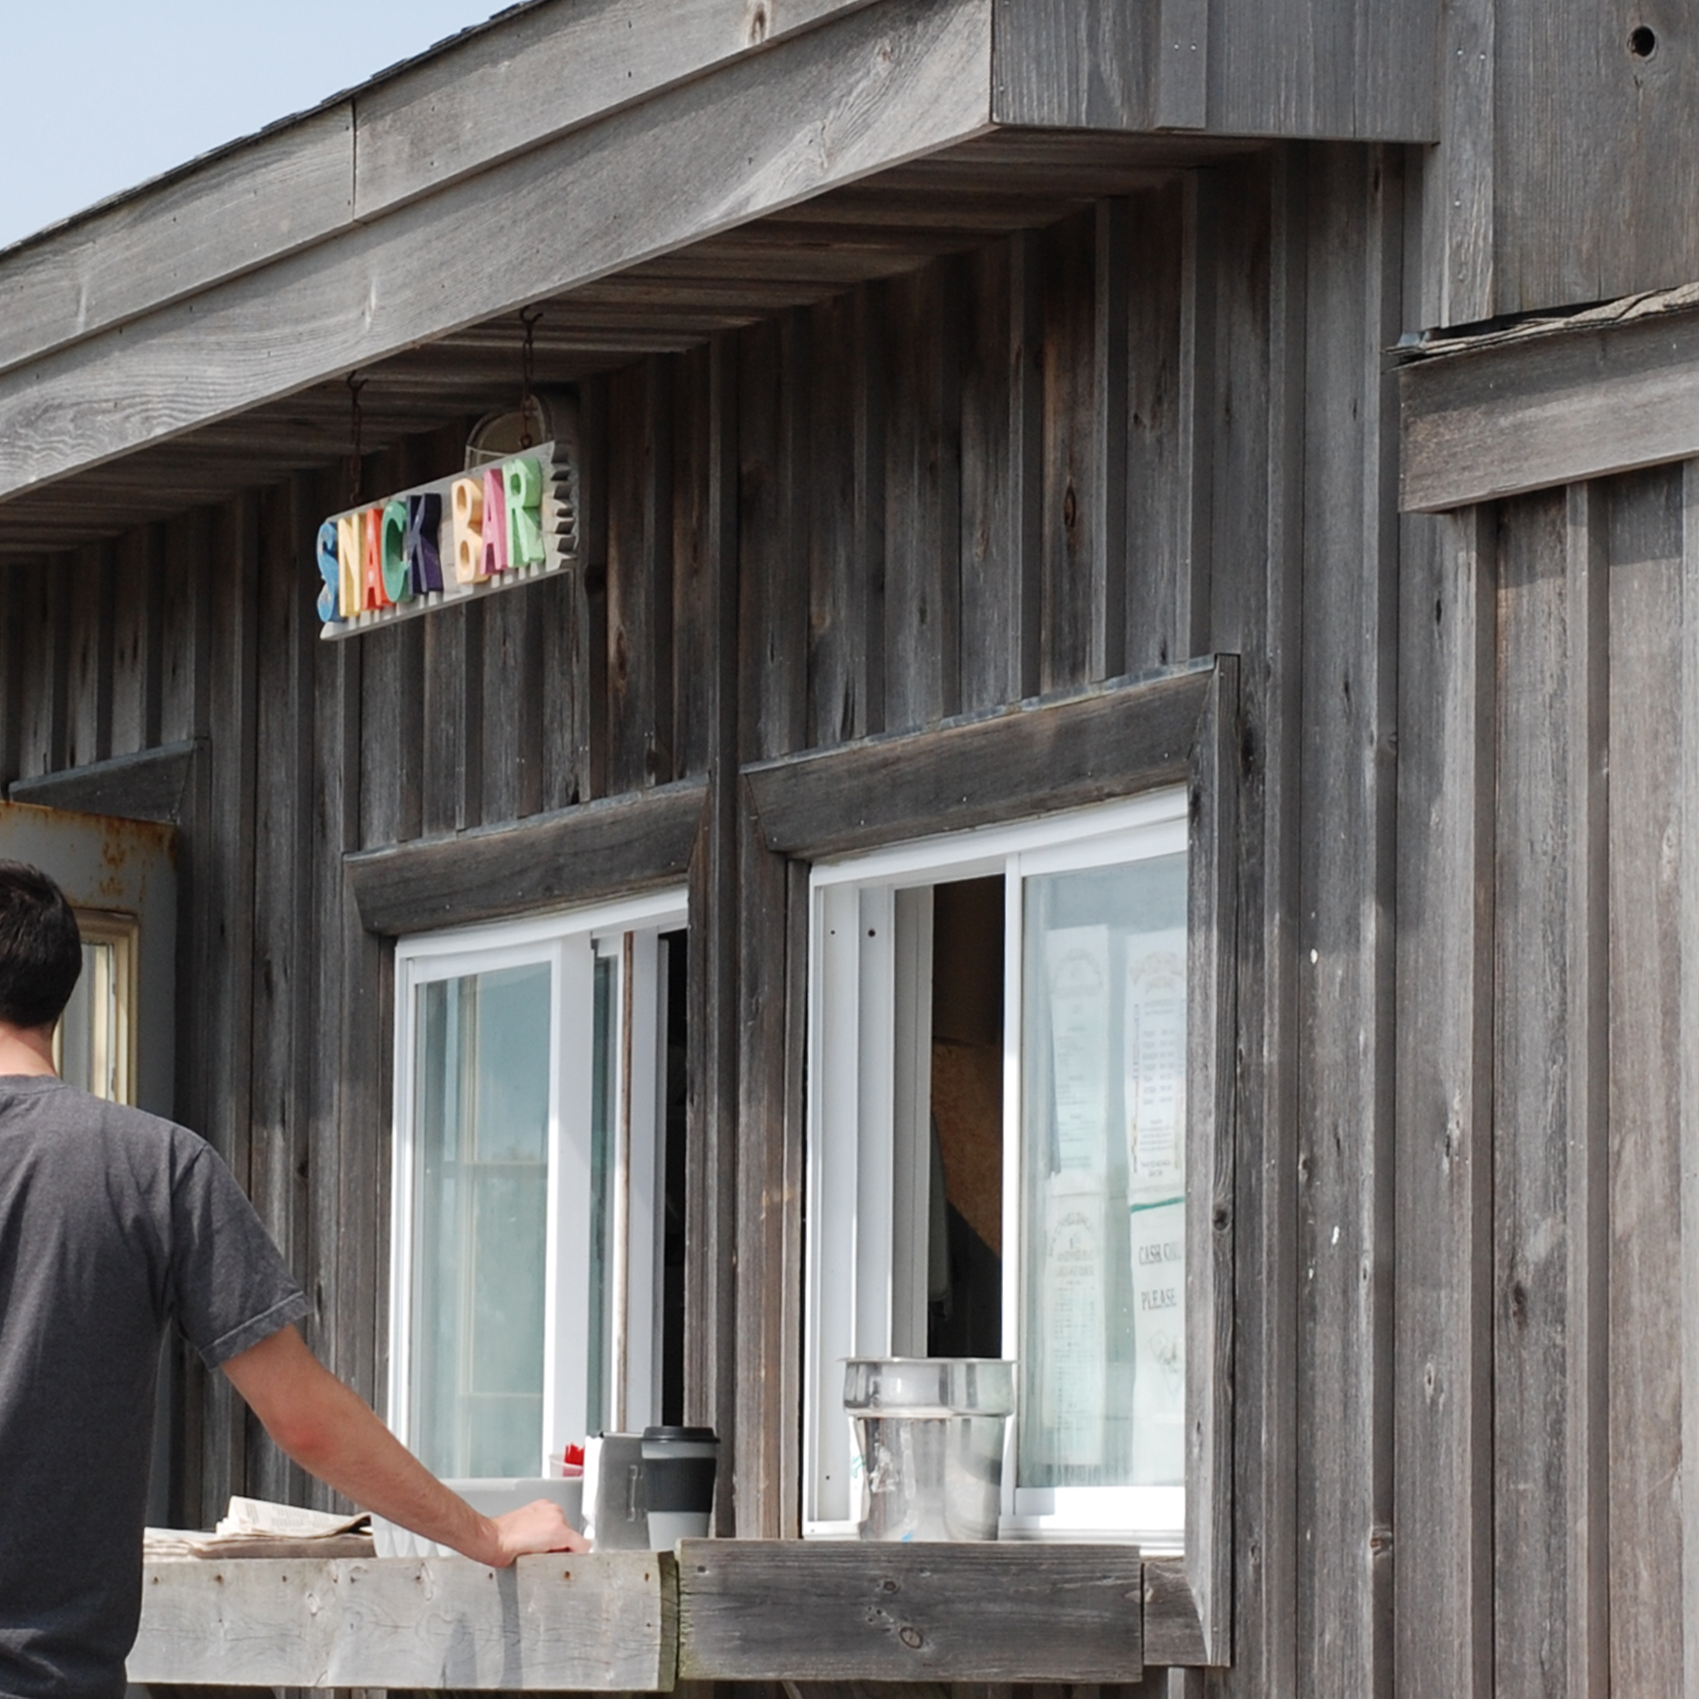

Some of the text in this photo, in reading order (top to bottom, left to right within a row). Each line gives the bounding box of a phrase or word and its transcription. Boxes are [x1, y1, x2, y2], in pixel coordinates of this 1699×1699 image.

[317, 457, 546, 623] SNACK BAR
[1139, 1244, 1162, 1266] CASH
[1141, 1287, 1177, 1311] PLEASE
